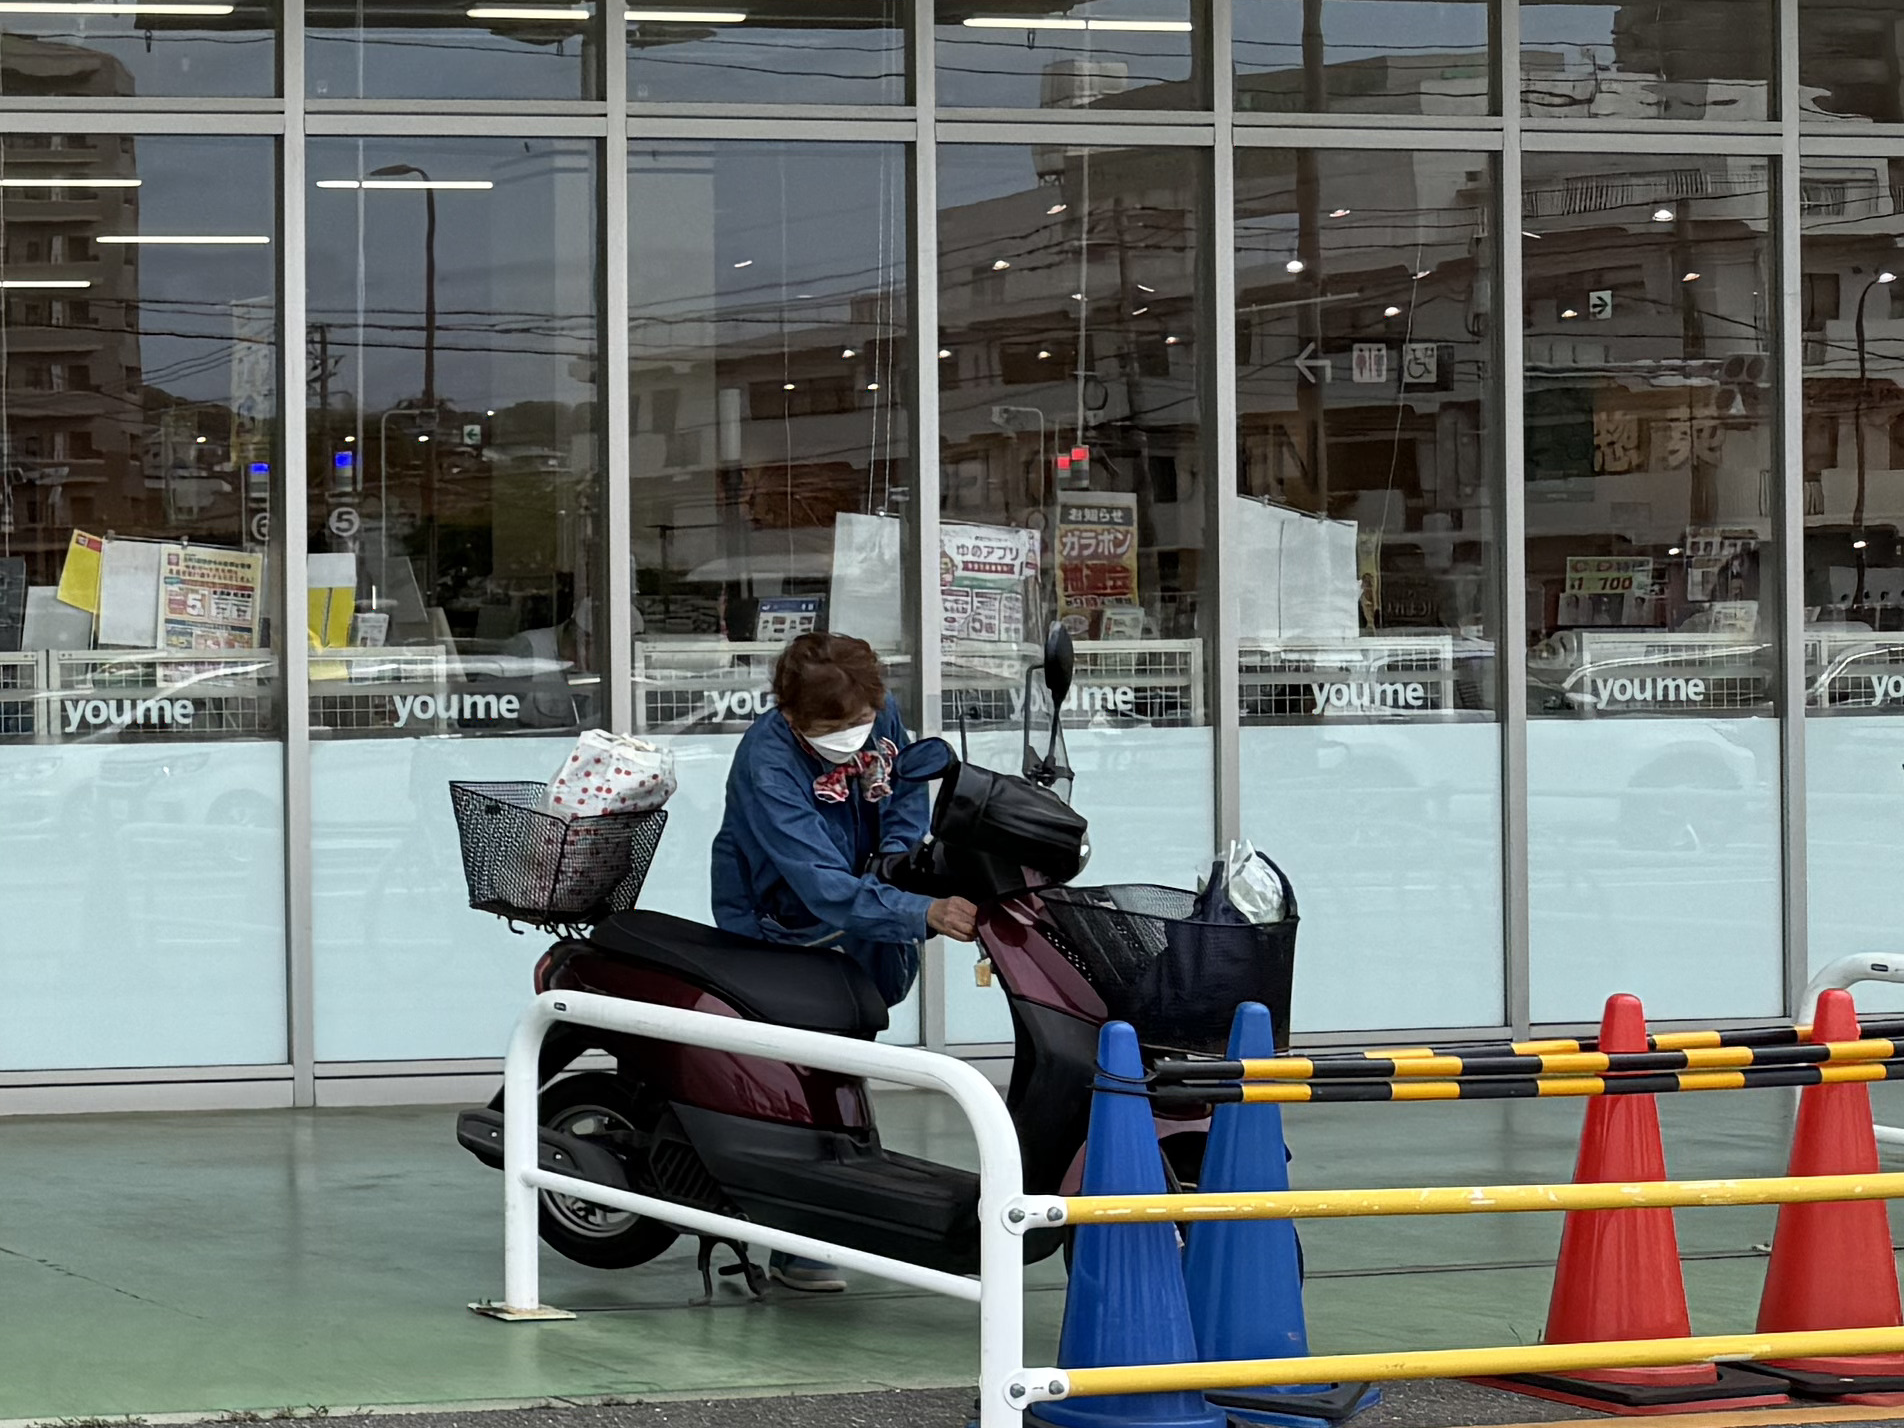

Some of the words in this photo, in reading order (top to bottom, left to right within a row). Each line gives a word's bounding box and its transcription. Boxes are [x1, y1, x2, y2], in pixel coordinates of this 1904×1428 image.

[335, 510, 355, 533] 5
[1068, 507, 1125, 523] お知らせ
[711, 689, 777, 723] you
